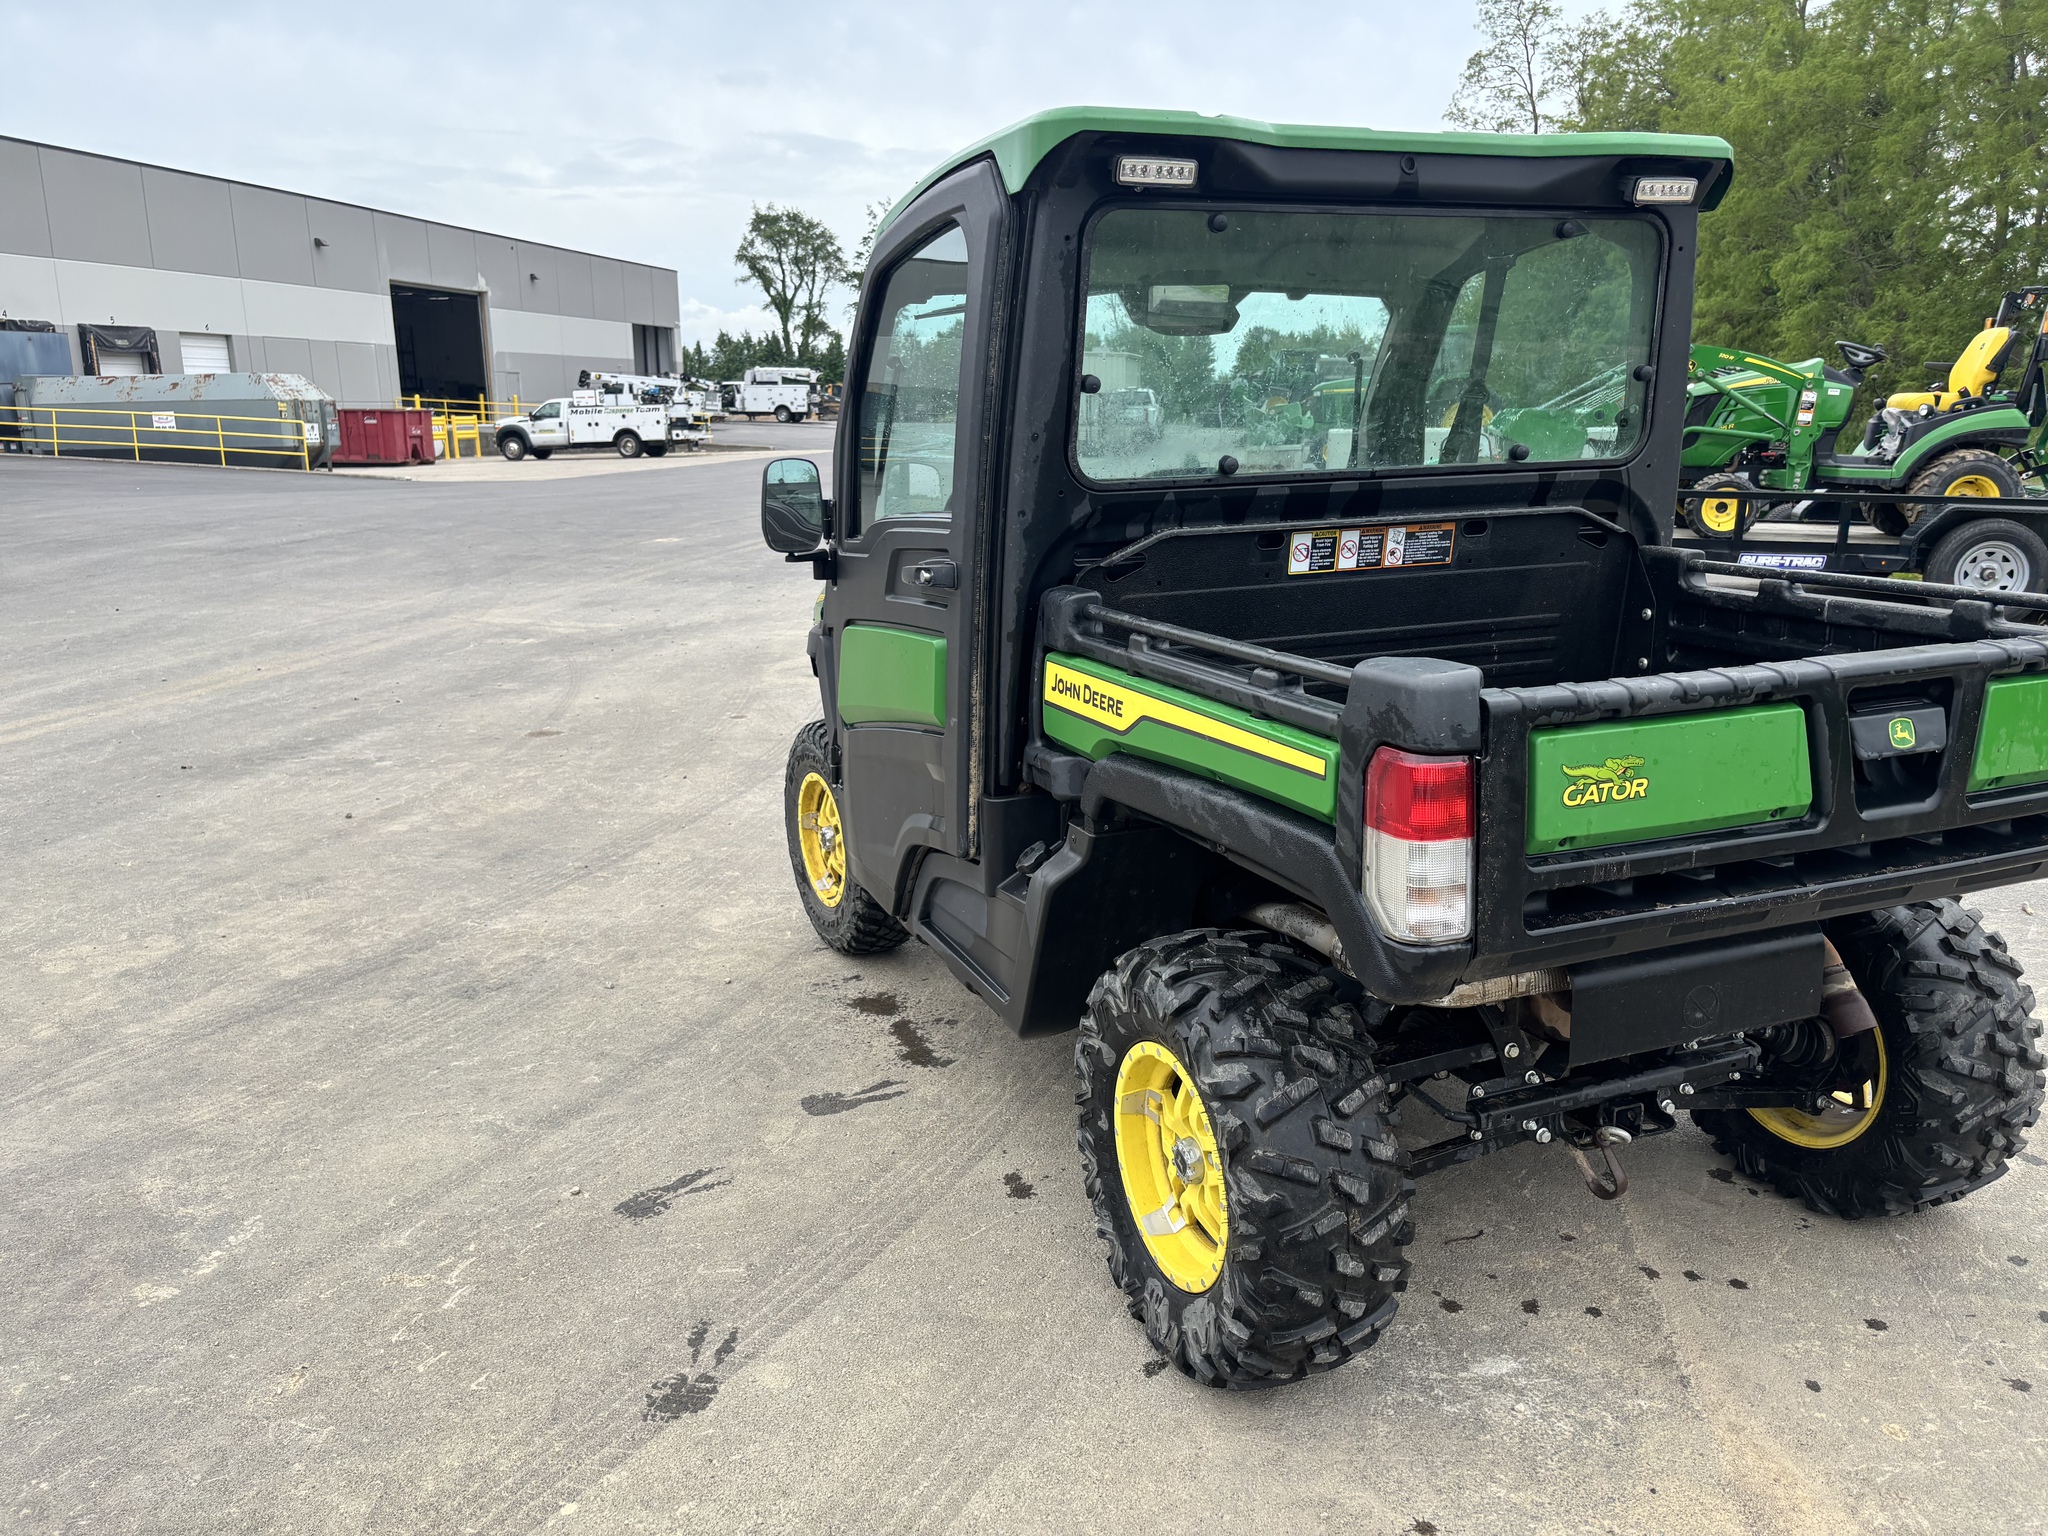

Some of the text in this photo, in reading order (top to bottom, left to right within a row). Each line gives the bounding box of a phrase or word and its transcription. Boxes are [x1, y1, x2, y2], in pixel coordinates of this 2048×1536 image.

[2, 308, 8, 319] 4
[109, 315, 115, 325] 5
[204, 323, 210, 331] 6
[1740, 555, 1824, 568] SURE-TRAC
[1051, 673, 1124, 718] JOHN DEERE
[1562, 777, 1649, 807] GATOR
